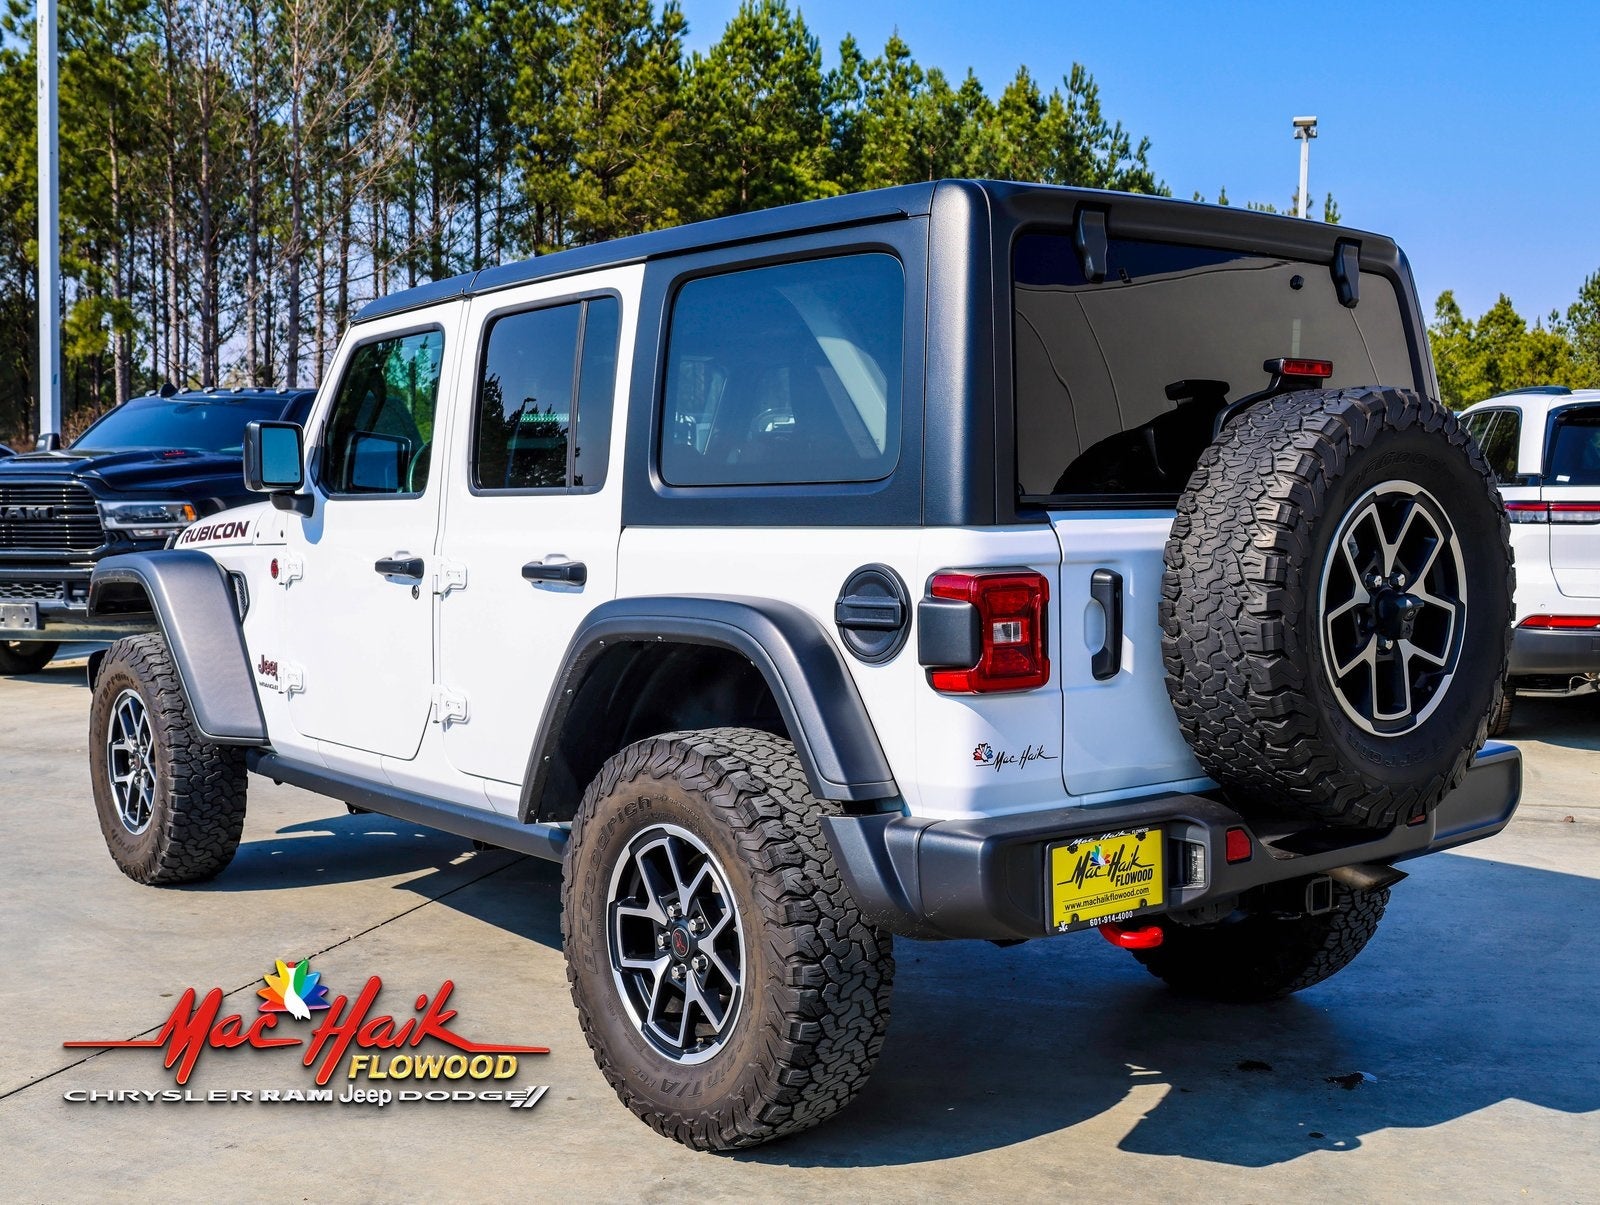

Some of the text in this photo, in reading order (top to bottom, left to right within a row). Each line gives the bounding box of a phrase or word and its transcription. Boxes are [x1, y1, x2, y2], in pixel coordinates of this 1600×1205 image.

[0, 505, 54, 519] AM
[180, 521, 250, 544] RUBICON
[259, 681, 279, 690] WRANGLE
[976, 745, 1058, 772] Mac Haik
[1057, 843, 1155, 889] Mac Haik
[1115, 868, 1153, 887] FLOWOOD
[1064, 886, 1150, 911] www.machaikflowood.com
[1089, 911, 1134, 926] 601-914-4000
